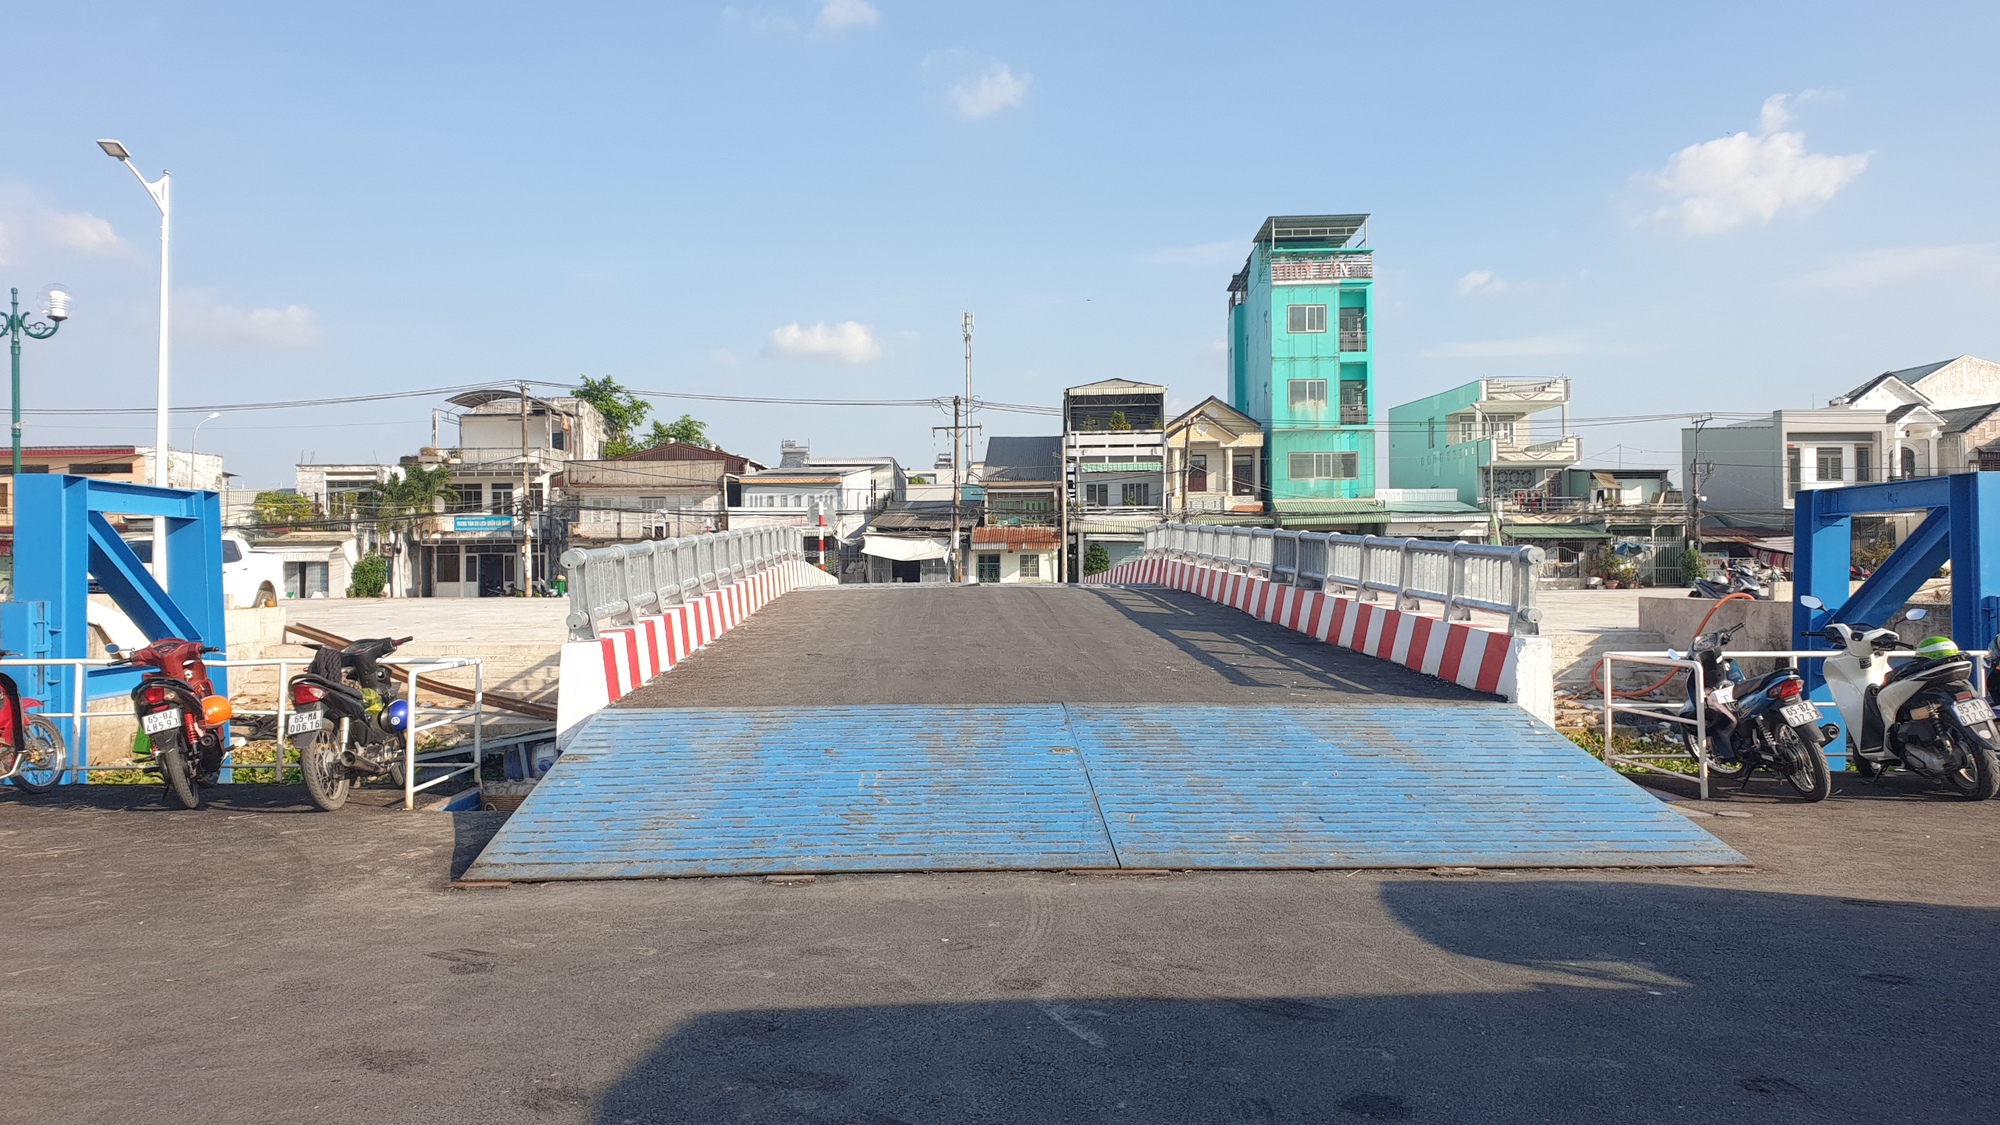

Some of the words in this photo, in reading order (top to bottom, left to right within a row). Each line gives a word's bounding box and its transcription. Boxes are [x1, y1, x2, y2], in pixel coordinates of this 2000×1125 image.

[1320, 262, 1350, 277] LAN
[1786, 702, 1811, 716] 65-B2
[1957, 700, 1983, 714] 95-M1
[147, 710, 173, 724] 65-B2
[294, 711, 317, 724] 65-MA
[146, 717, 179, 732] 485.93
[290, 720, 320, 733] 006.16
